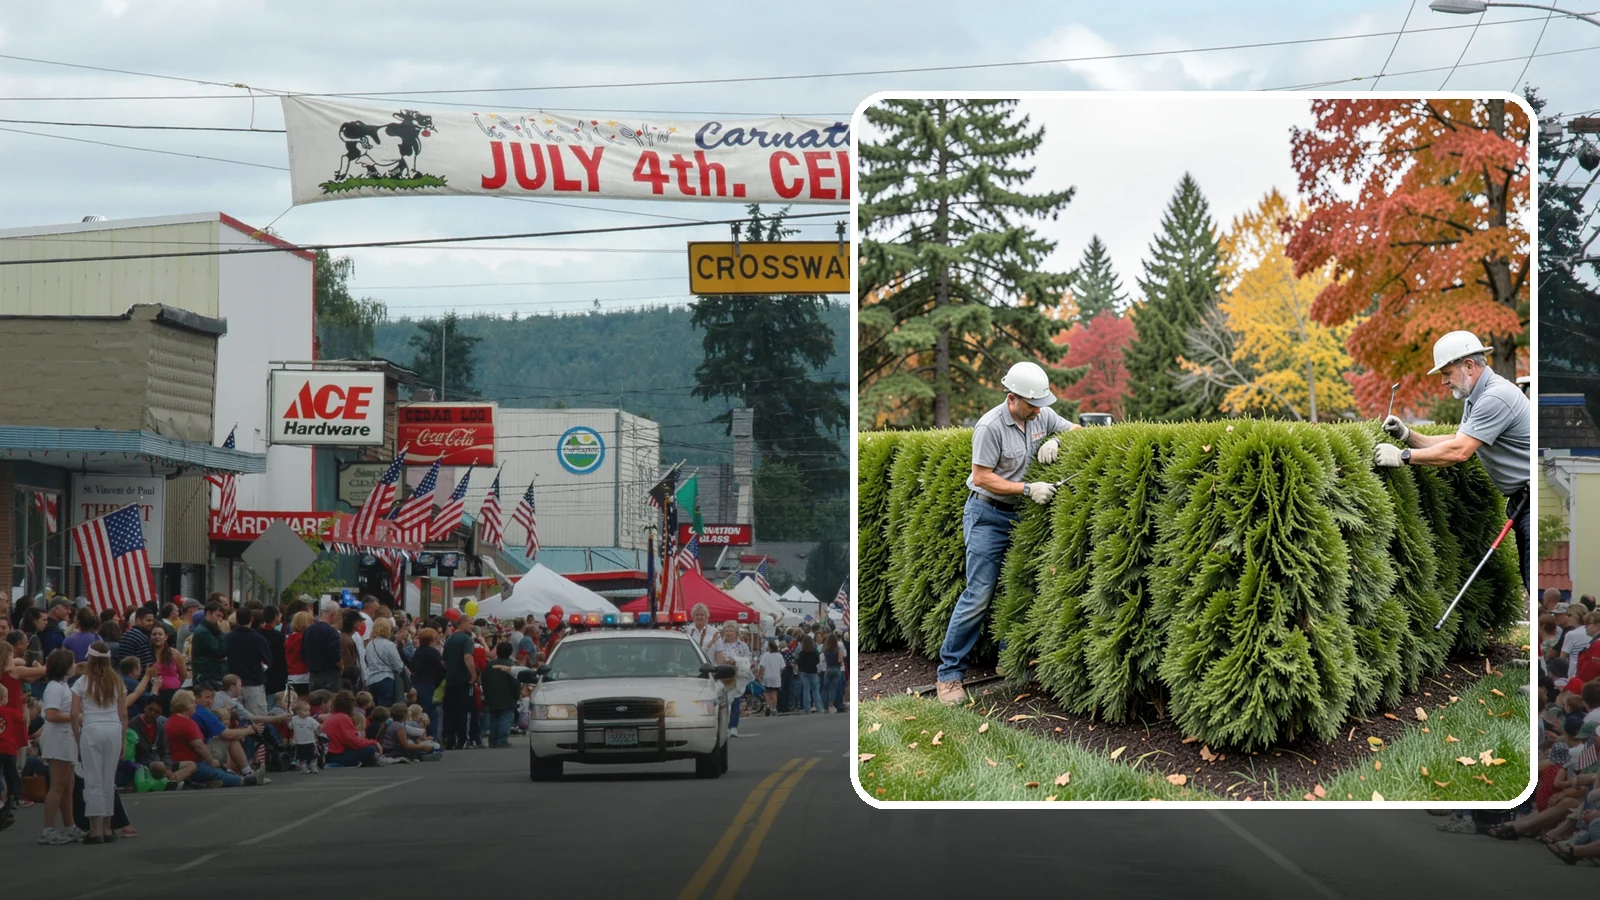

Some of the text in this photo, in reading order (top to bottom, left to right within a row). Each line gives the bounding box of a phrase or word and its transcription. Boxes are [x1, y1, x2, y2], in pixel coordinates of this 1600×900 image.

[481, 141, 605, 192] JULY
[632, 150, 746, 197] 4th.
[697, 254, 850, 280] CROSSWA
[283, 380, 373, 420] ACE
[406, 409, 485, 422] CEDAR LOG
[283, 421, 370, 436] Hardware
[416, 428, 477, 446] Coca-Cola
[353, 467, 384, 480] Simpl
[83, 485, 155, 495] St. Vincent de Paul
[688, 526, 741, 535] CRNATION
[699, 535, 730, 543] GLASS
